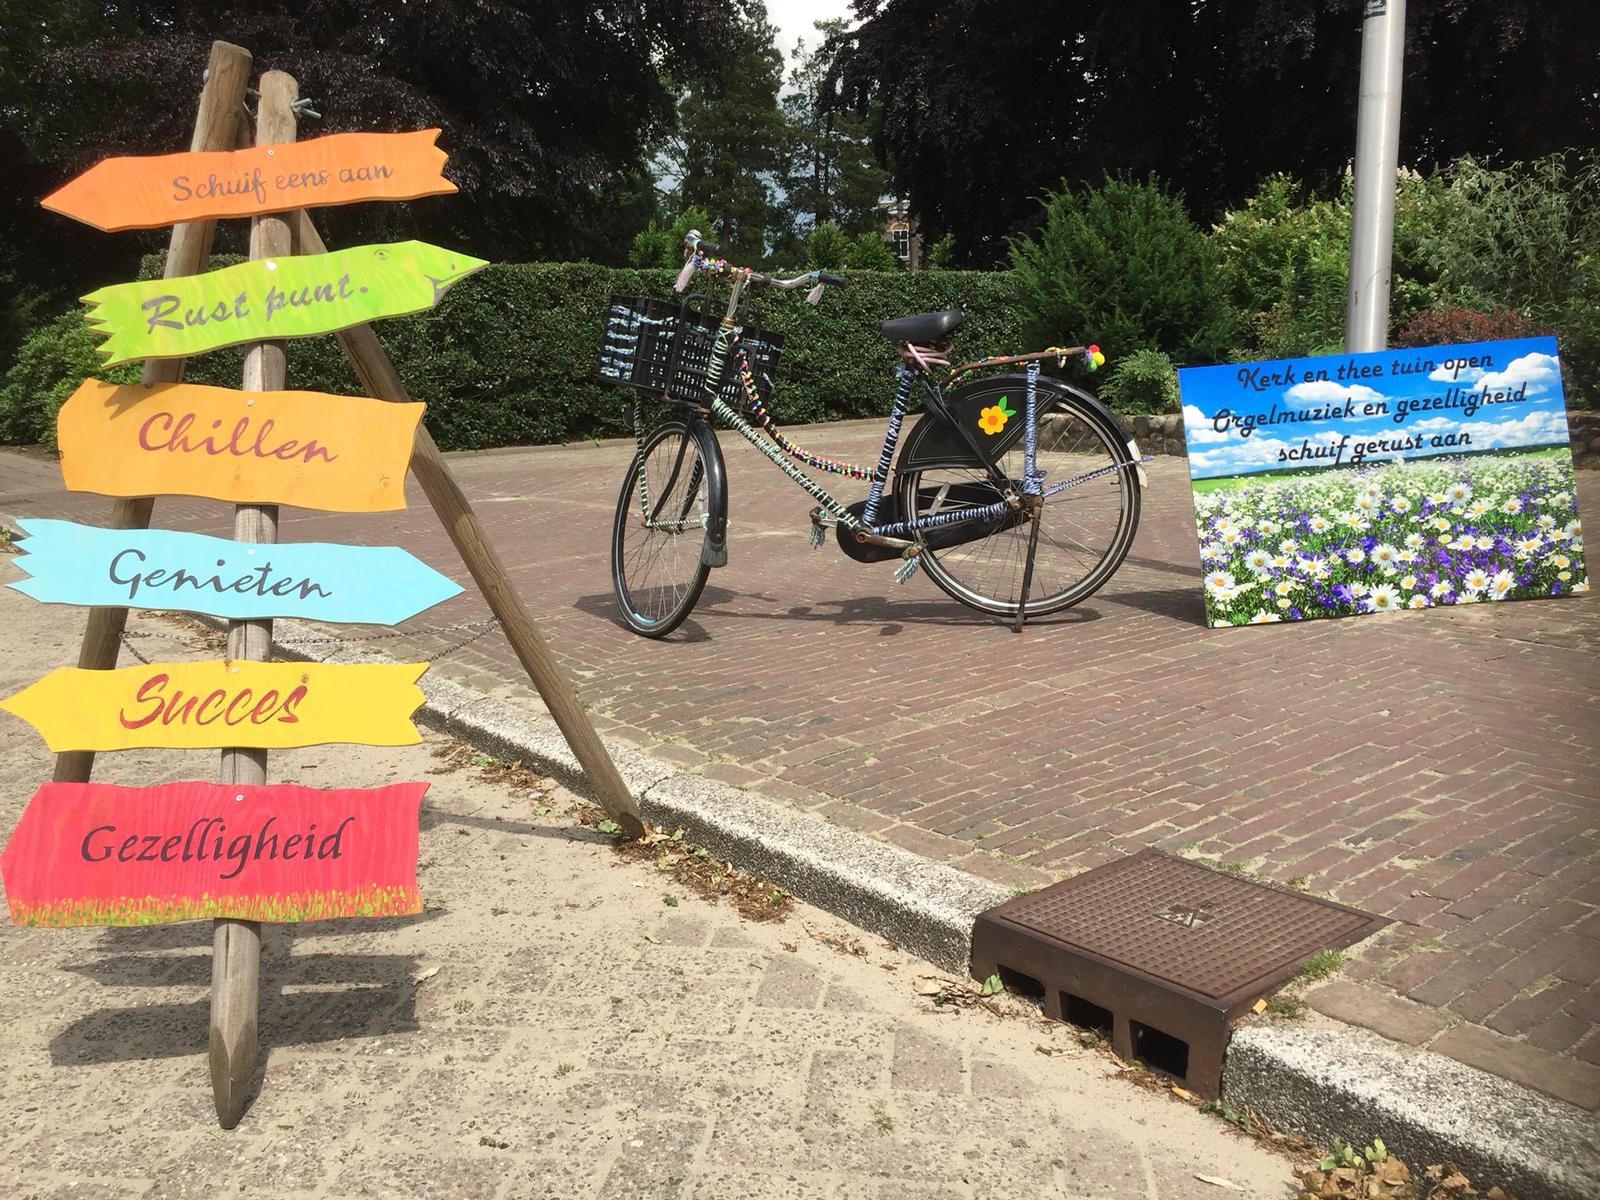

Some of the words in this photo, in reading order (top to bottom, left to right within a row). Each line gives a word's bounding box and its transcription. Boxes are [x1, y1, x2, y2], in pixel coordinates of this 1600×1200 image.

[172, 168, 266, 203] Schuif
[275, 170, 330, 190] eens
[339, 164, 393, 183] aan
[141, 291, 250, 334] Rust
[265, 273, 369, 320] punt.
[1237, 364, 1295, 392] Kerk
[1303, 366, 1328, 384] en
[1337, 358, 1384, 379] thee
[1391, 356, 1435, 376] tuin
[1443, 352, 1494, 378] open
[1212, 398, 1355, 437] Orgelmuziek
[1363, 403, 1389, 417] en
[1393, 382, 1527, 423] gezelligheid
[138, 412, 337, 463] Chillen
[1278, 435, 1349, 464] schuif
[1354, 437, 1423, 463] gerust
[1430, 432, 1472, 447] aan
[108, 548, 333, 599] Genieten
[80, 816, 355, 879] Gezelligheid
